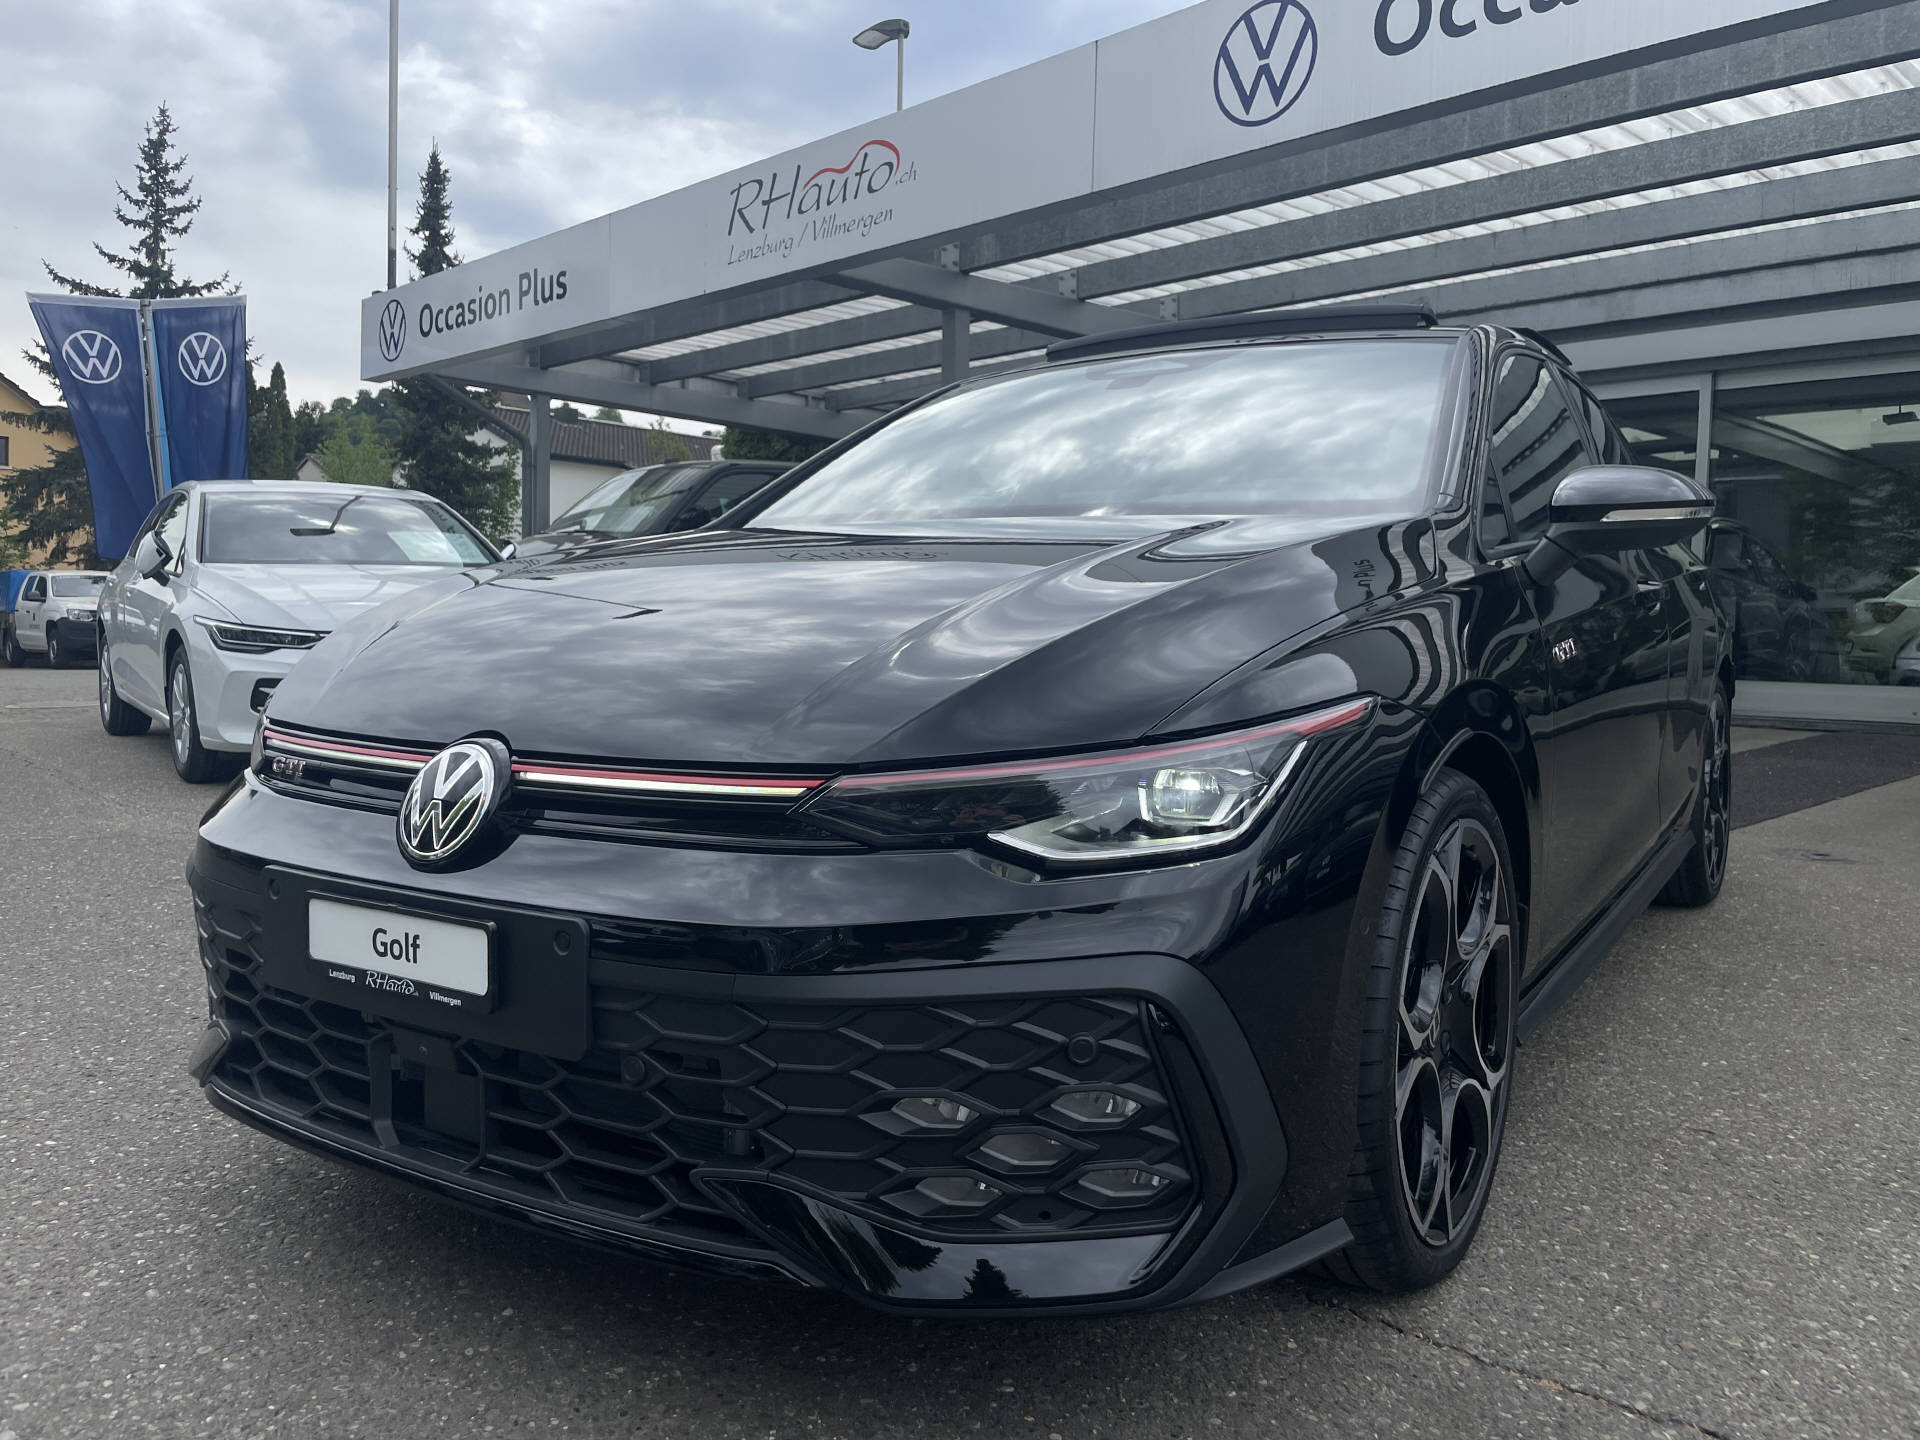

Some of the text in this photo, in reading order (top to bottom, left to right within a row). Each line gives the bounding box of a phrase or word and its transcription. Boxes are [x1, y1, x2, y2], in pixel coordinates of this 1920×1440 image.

[1374, 0, 1579, 56] Oc
[728, 234, 793, 265] Lenzburg
[812, 208, 893, 236] Villmergen
[419, 286, 510, 338] Occasion
[518, 269, 568, 310] Plus
[271, 756, 306, 777] GTI
[372, 928, 420, 964] Golf
[329, 969, 462, 1006] Lenzburg RHauto Villmergen
